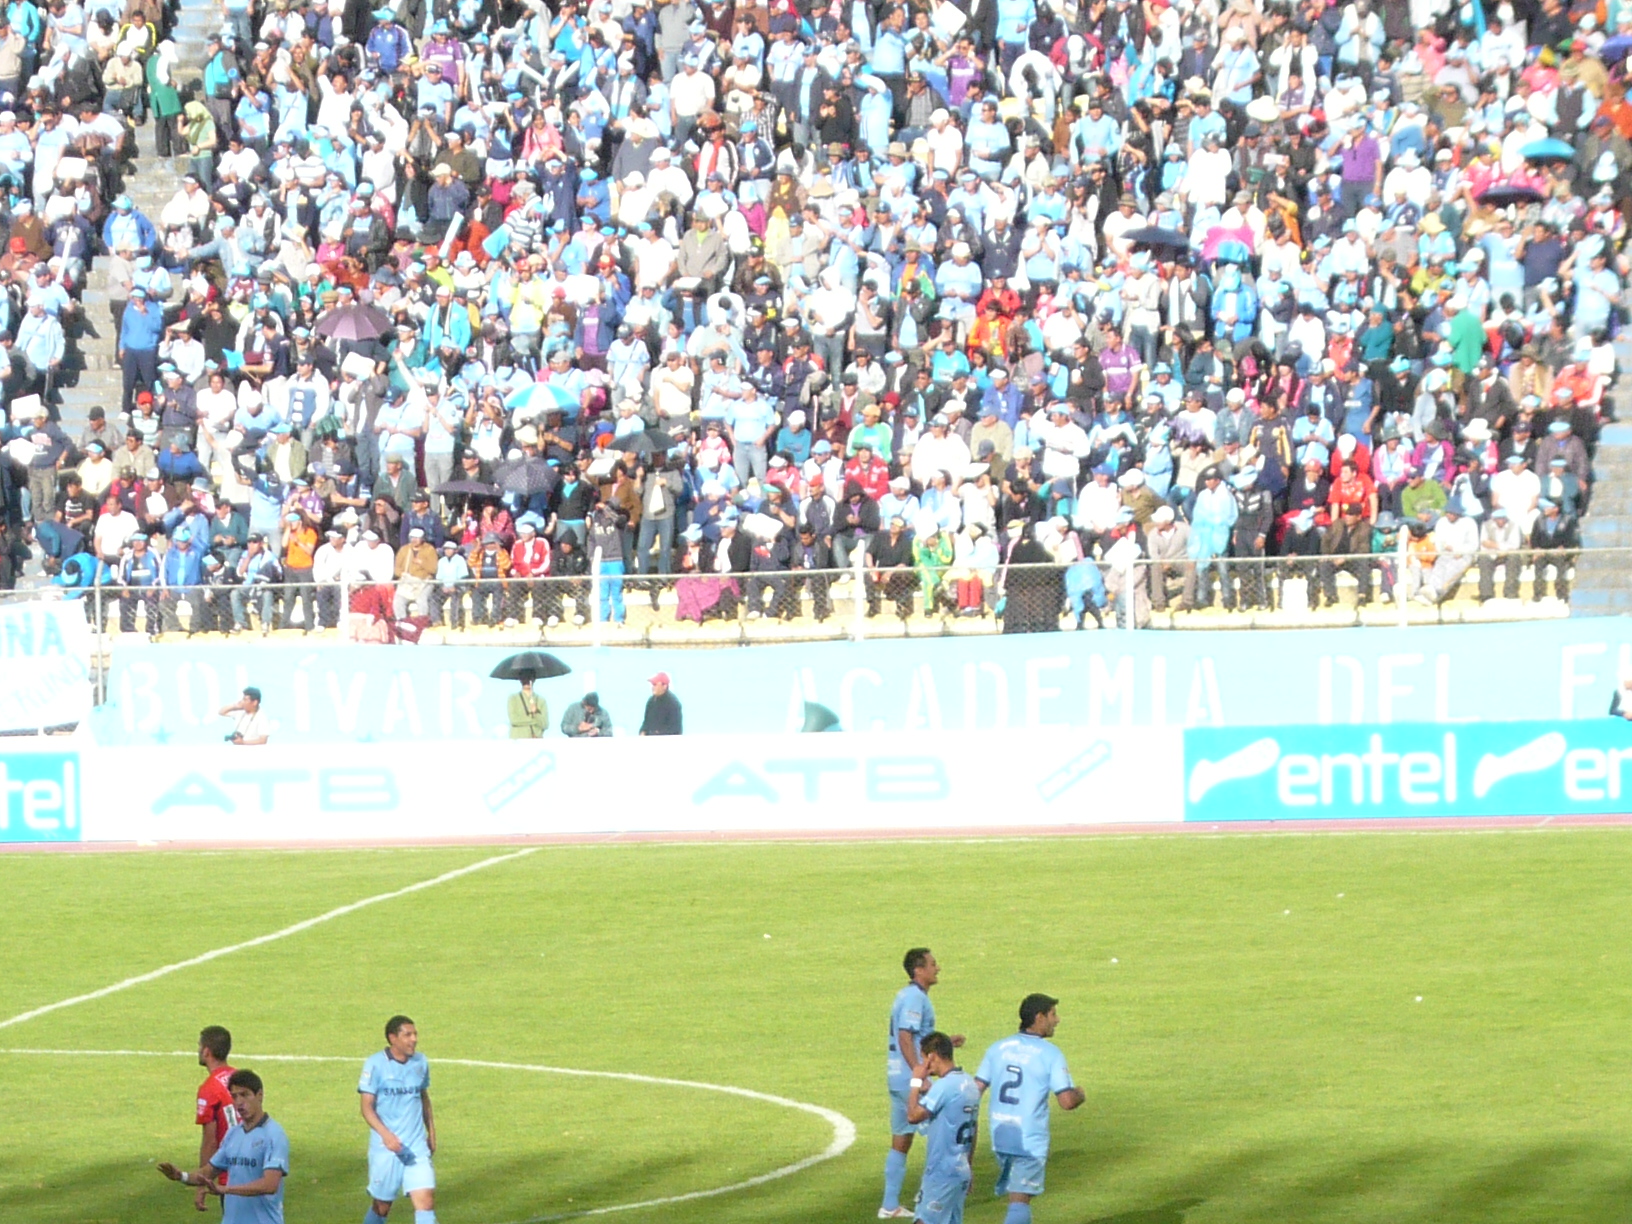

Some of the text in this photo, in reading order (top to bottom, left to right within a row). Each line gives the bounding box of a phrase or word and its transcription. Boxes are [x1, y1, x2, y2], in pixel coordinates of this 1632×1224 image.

[1317, 652, 1481, 724] DEL
[150, 765, 402, 815] ATB
[691, 755, 952, 806] ATB
[1277, 731, 1458, 805] entel
[998, 1064, 1024, 1106] 2
